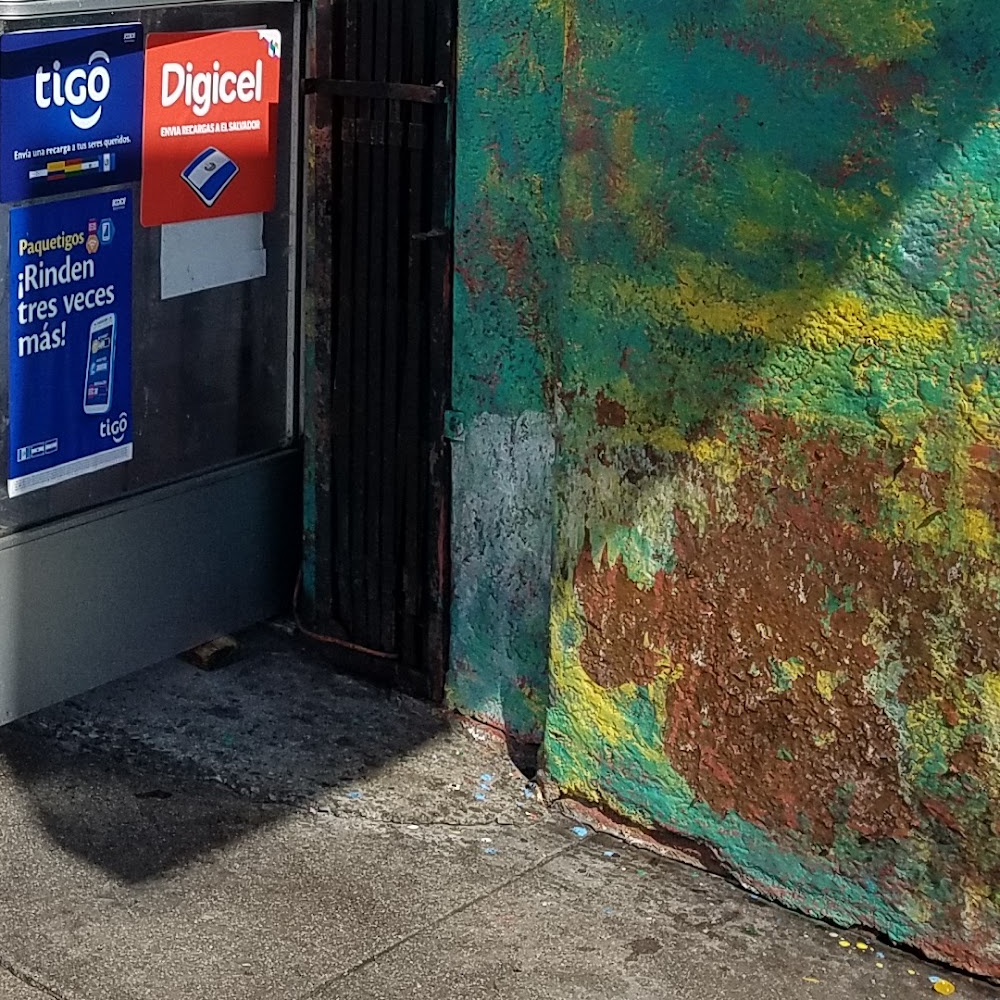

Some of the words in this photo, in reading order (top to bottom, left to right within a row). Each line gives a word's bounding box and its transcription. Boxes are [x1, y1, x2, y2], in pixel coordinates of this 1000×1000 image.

[35, 51, 111, 130] tigo
[161, 59, 262, 117] Digicel
[14, 148, 31, 160] Envía
[32, 147, 45, 156] una
[46, 144, 71, 155] recarga
[76, 141, 87, 150] tus
[87, 139, 103, 149] seres
[103, 134, 132, 148] queridos.
[160, 125, 181, 137] ENVIA
[181, 122, 214, 135] RECARGAS
[228, 119, 261, 131] SALVADOR
[18, 231, 85, 257] Paquetigos
[17, 254, 95, 300] ¡Rinden
[17, 297, 58, 325] tres
[63, 284, 115, 315] veces
[18, 320, 67, 358] más!
[99, 411, 128, 443] tigo
